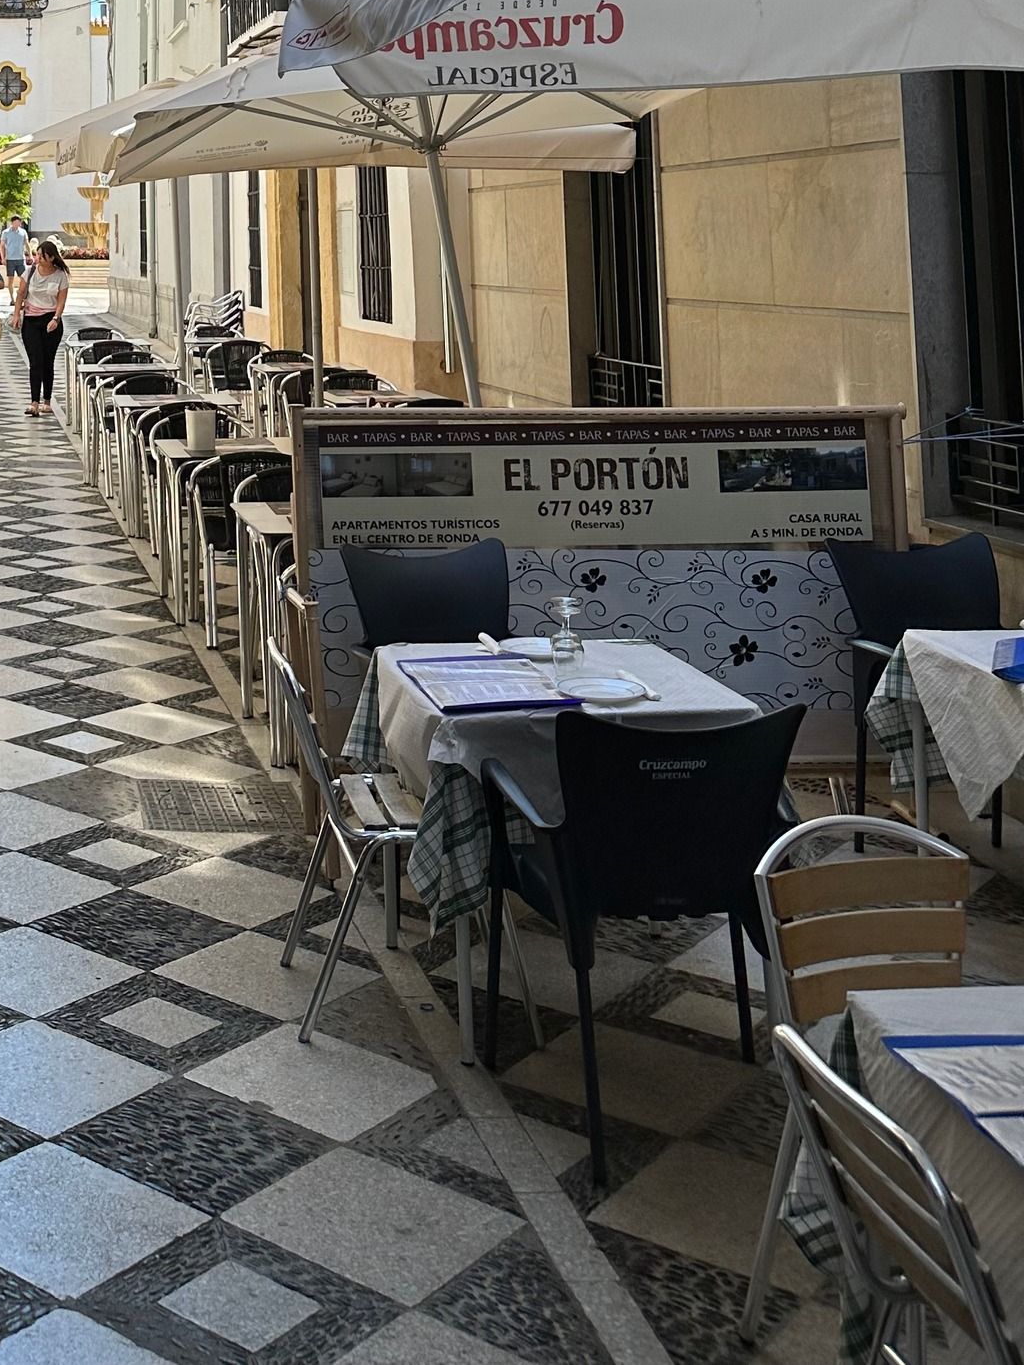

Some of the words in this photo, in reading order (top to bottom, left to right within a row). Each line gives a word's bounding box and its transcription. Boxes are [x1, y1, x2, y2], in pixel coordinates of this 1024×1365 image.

[327, 434, 349, 443] BAR
[362, 433, 396, 443] TAPAS
[410, 433, 433, 442] BAR
[447, 432, 481, 442] TAPAS
[495, 432, 517, 441] BAR
[530, 431, 565, 441] TAPAS
[579, 431, 602, 441] BAR
[615, 430, 650, 439] TAPAS
[664, 429, 687, 439] BAR
[700, 428, 735, 438] TAPAS
[749, 427, 772, 438] BAR
[785, 427, 820, 437] TAPAS
[833, 426, 856, 436] BAR
[504, 458, 541, 491] EL
[550, 446, 689, 491] PORTÓN
[538, 500, 572, 516] 677
[579, 500, 613, 516] 049
[620, 499, 653, 515] 837
[332, 520, 427, 531] APARTAMENTOS
[430, 516, 500, 529] TURÍSTICOS
[789, 514, 821, 523] CASA
[823, 513, 862, 522] RURAL
[571, 519, 625, 531] (Reservas)
[750, 529, 760, 538] A
[762, 528, 769, 538] 5
[771, 528, 798, 537] MIN.
[802, 527, 816, 537] DE
[819, 527, 863, 537] RONDA
[332, 534, 349, 544] EN
[352, 534, 365, 544] EL
[367, 534, 415, 544] CENTRO
[418, 534, 433, 543] DE
[436, 534, 480, 543] RONDA
[639, 759, 707, 771] Cruzcampo
[652, 772, 692, 780] ESPECIAL
